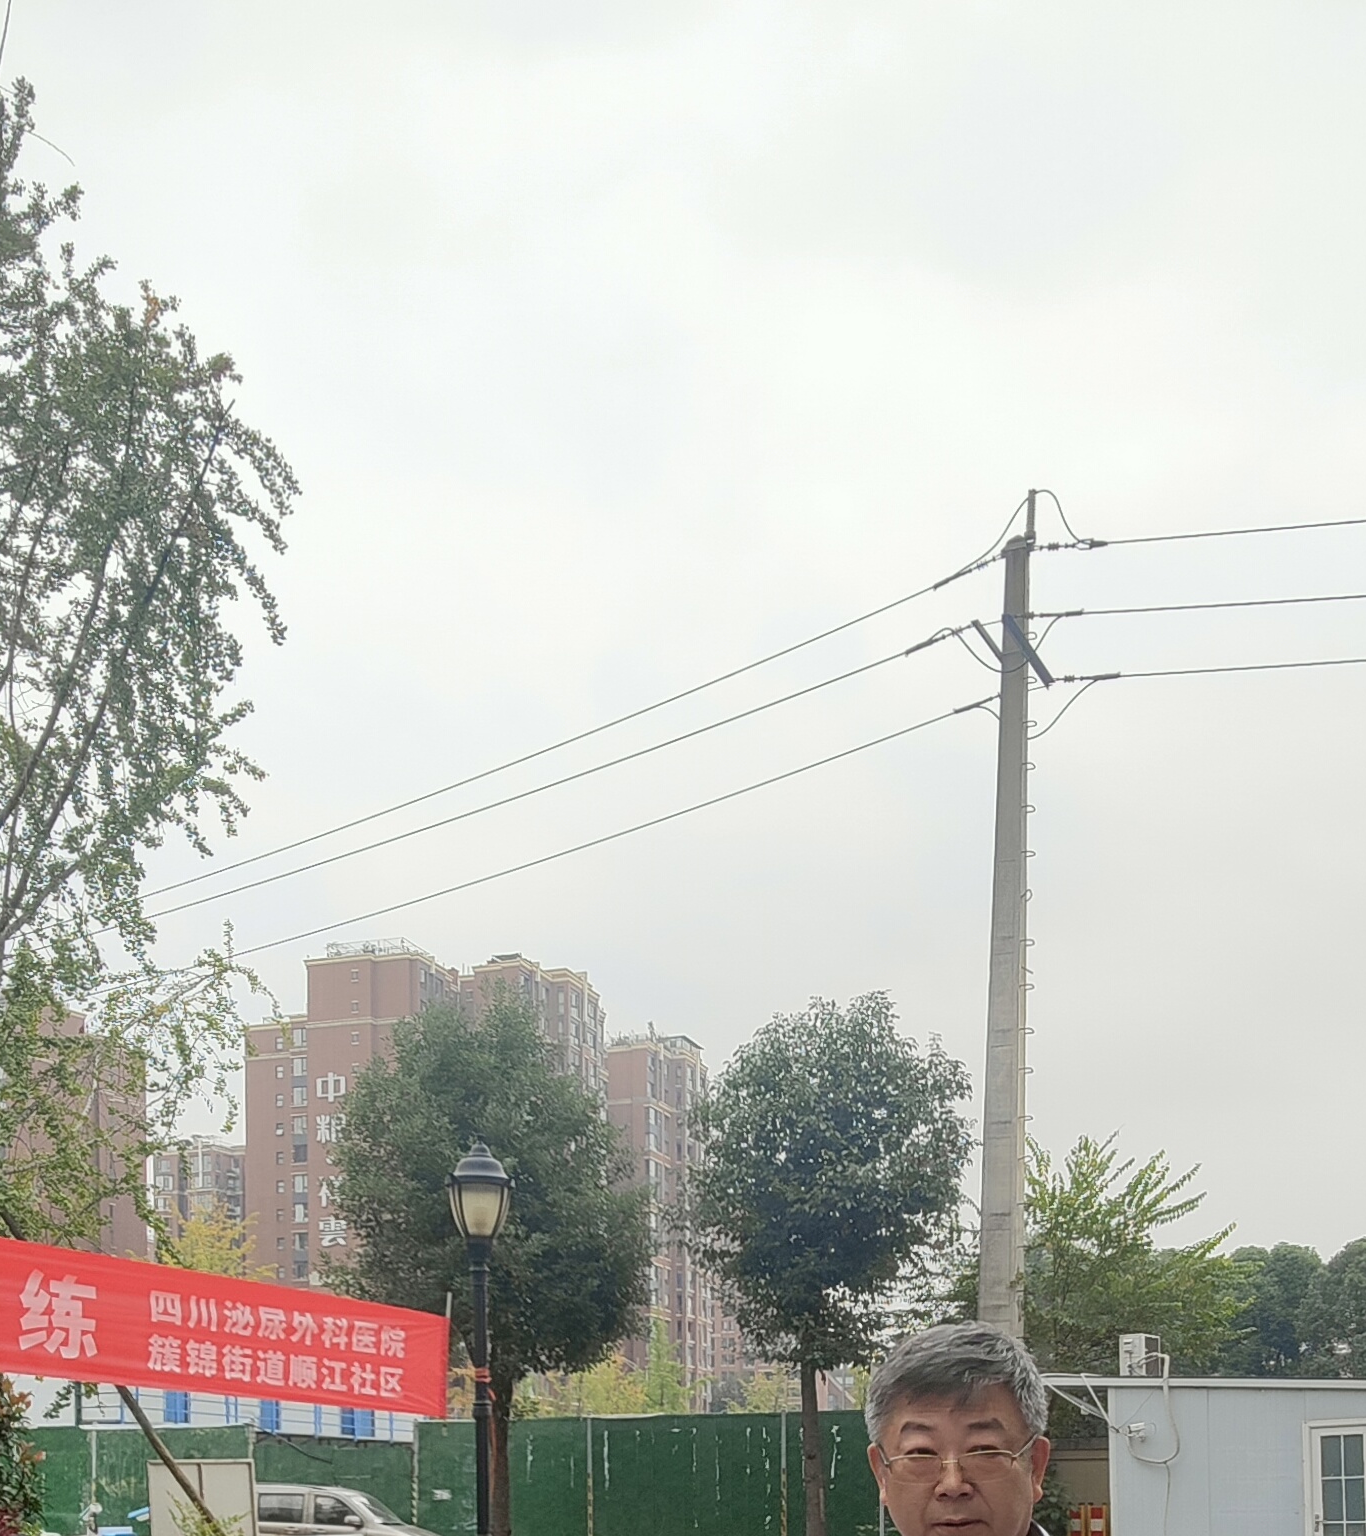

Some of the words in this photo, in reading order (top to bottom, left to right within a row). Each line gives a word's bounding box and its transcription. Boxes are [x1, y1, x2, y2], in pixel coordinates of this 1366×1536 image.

[149, 1290, 406, 1358] 四川泌尿外科医院
[147, 1333, 404, 1398] 簇锦街道顺江社区
